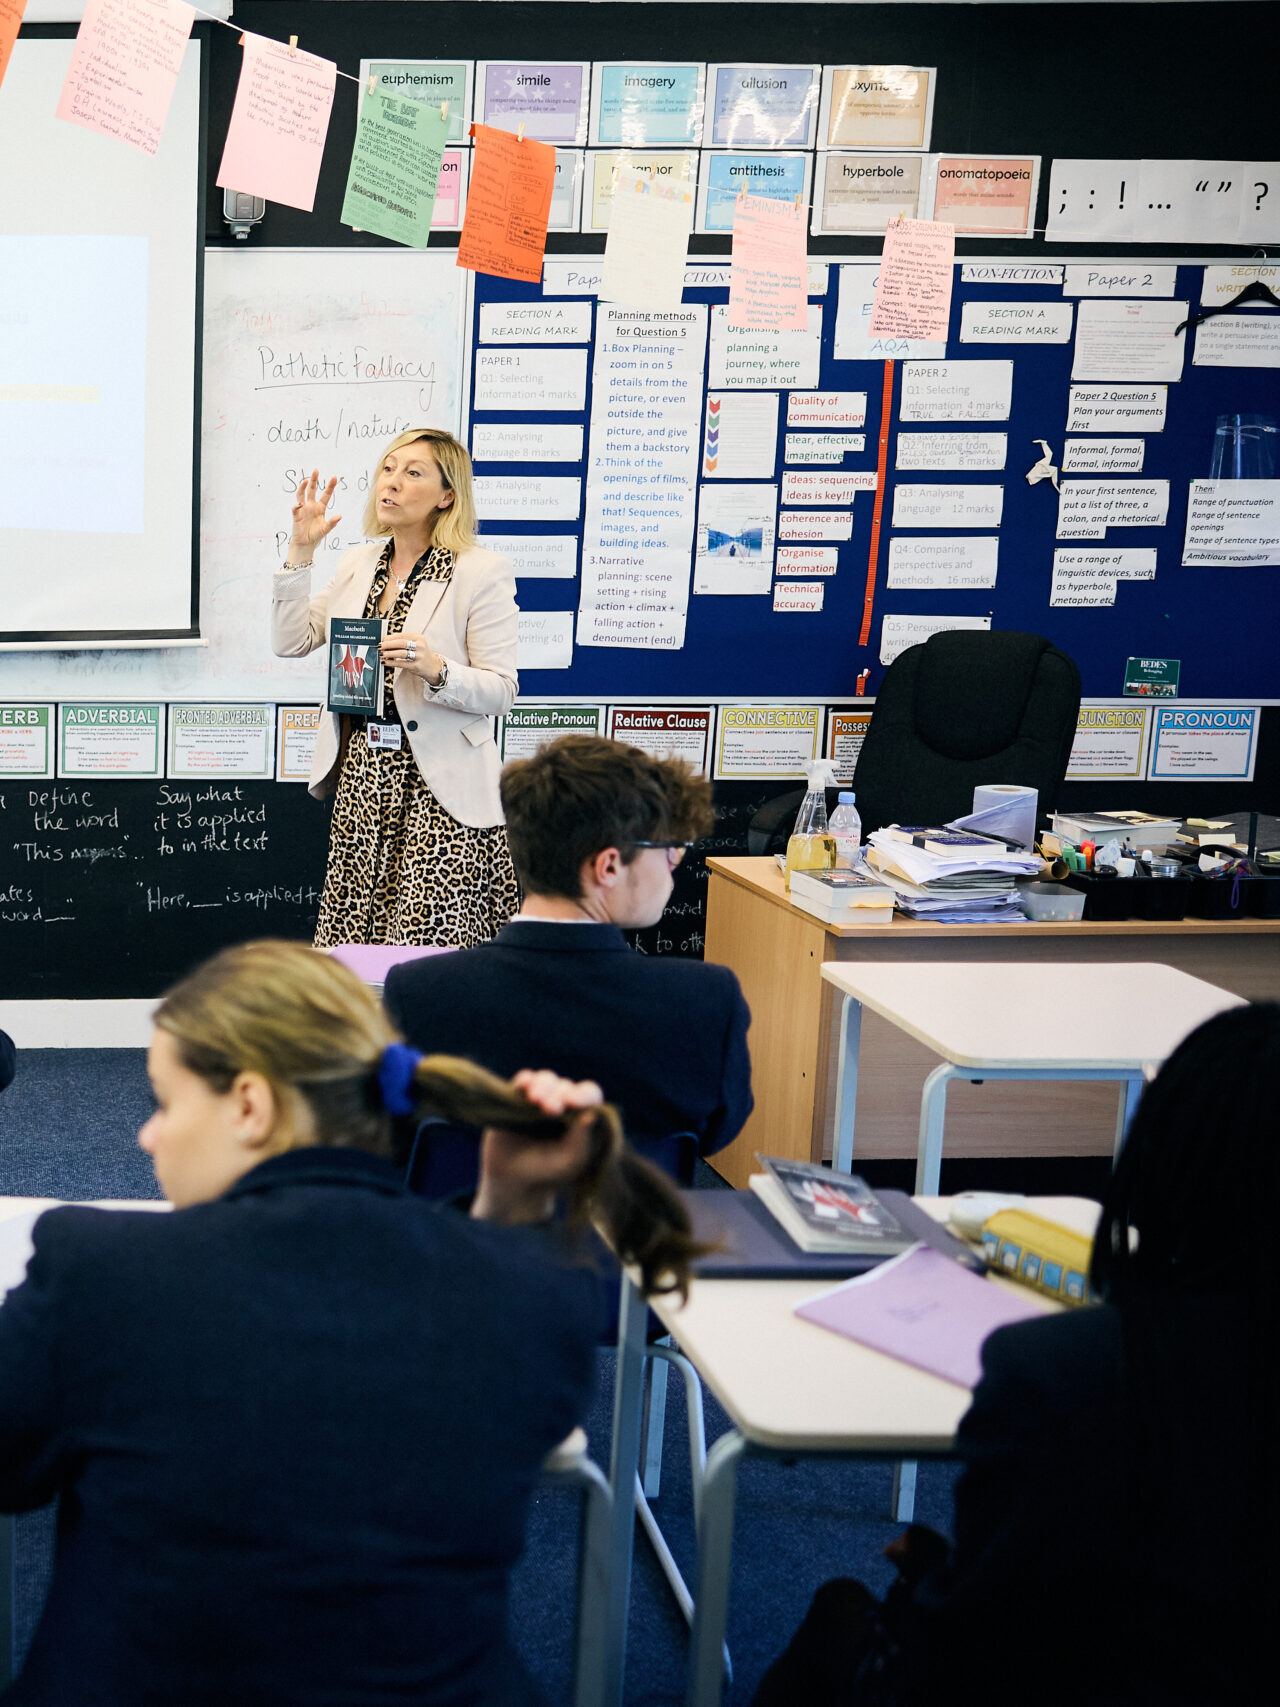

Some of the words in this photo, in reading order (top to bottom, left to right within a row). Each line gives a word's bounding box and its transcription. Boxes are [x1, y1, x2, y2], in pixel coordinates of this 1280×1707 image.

[382, 74, 453, 88] euphemism
[517, 75, 551, 86] simile
[624, 76, 675, 89] imagery
[742, 78, 787, 89] allusion
[730, 165, 785, 176] antithesis
[843, 165, 904, 180] hyperbole
[940, 169, 1030, 181] onomatopoeia
[967, 268, 1058, 279] NON-FICTION
[1088, 273, 1136, 288] Paper
[1142, 275, 1153, 286] 2
[507, 310, 551, 318] SECTION
[555, 310, 563, 318] A
[608, 311, 650, 321] Planning
[653, 312, 696, 320] methods
[988, 309, 1033, 318] SECTION
[1038, 310, 1045, 318] A
[492, 327, 542, 335] READING
[545, 327, 578, 335] MARK
[616, 327, 630, 335] for
[633, 327, 678, 337] Question
[681, 328, 686, 336] 5
[973, 326, 1022, 335] READING
[1025, 326, 1059, 335] MARK
[633, 344, 674, 355] Planning
[727, 344, 769, 354] planning
[872, 339, 910, 353] AQA
[726, 360, 766, 369] journey,
[770, 359, 800, 368] where
[908, 369, 939, 377] PAPER
[942, 369, 948, 377] 2
[258, 346, 348, 380] Pathetic
[353, 346, 436, 412] Fallacy
[610, 378, 642, 386] details
[645, 378, 668, 387] from
[672, 379, 688, 387] the
[725, 377, 743, 385] you
[746, 377, 767, 385] map
[771, 375, 776, 384] it
[780, 376, 796, 384] out
[790, 396, 825, 407] Quality
[828, 397, 838, 405] of
[1074, 392, 1101, 401] Paper
[1110, 392, 1148, 401] Question
[1151, 392, 1156, 400] 5
[1073, 407, 1092, 415] Plan
[1116, 408, 1163, 416] arguments
[788, 413, 864, 421] communication
[268, 418, 330, 442] death
[1071, 421, 1089, 430] first
[787, 435, 814, 445] clear,
[817, 436, 861, 445] effective,
[1069, 446, 1109, 455] Informal,
[1110, 446, 1142, 455] formal,
[786, 452, 844, 461] imaginative
[1067, 460, 1099, 469] formal,
[1102, 460, 1139, 469] informal
[603, 474, 647, 484] openings
[650, 475, 661, 483] of
[662, 475, 688, 484] films,
[788, 475, 817, 484] ideas:
[819, 476, 873, 486] sequencing
[786, 491, 812, 499] ideas
[815, 491, 822, 499] is
[825, 491, 853, 501] key!!!
[1076, 488, 1095, 496] your
[1097, 487, 1115, 496] first
[1193, 499, 1217, 507] Range
[1218, 499, 1227, 507] of
[628, 508, 682, 518] Sequences,
[781, 515, 831, 523] coherence
[833, 514, 851, 523] and
[780, 530, 823, 538] cohesion
[1061, 529, 1099, 537] question
[600, 539, 638, 549] building
[781, 549, 824, 558] Organise
[777, 564, 835, 573] information
[1057, 569, 1096, 578] linguistic
[1098, 569, 1131, 578] devices,
[1134, 569, 1153, 577] such
[779, 584, 823, 593] Technical
[1068, 583, 1113, 591] hyperbole,
[774, 602, 816, 610] accuracy
[592, 634, 648, 644] denoument
[651, 636, 676, 646] (end)
[65, 710, 156, 724] ADVERBIAL
[175, 710, 217, 724] FRONTED
[218, 710, 267, 725] ADVERBIAL
[505, 711, 549, 725] Relative
[551, 712, 597, 725] Pronoun
[615, 713, 655, 728] Relative
[657, 713, 707, 728] Clause
[725, 711, 816, 726] CONNECTIVE
[1161, 712, 1252, 727] PRONOUN
[157, 785, 192, 817] Say
[196, 786, 244, 801] what
[34, 811, 68, 831] the
[75, 809, 119, 829] word
[154, 812, 170, 832] it
[177, 814, 192, 829] is
[198, 804, 266, 838] applied
[158, 836, 173, 856] to
[182, 838, 197, 852] in
[201, 834, 230, 851] the
[235, 830, 269, 851] text
